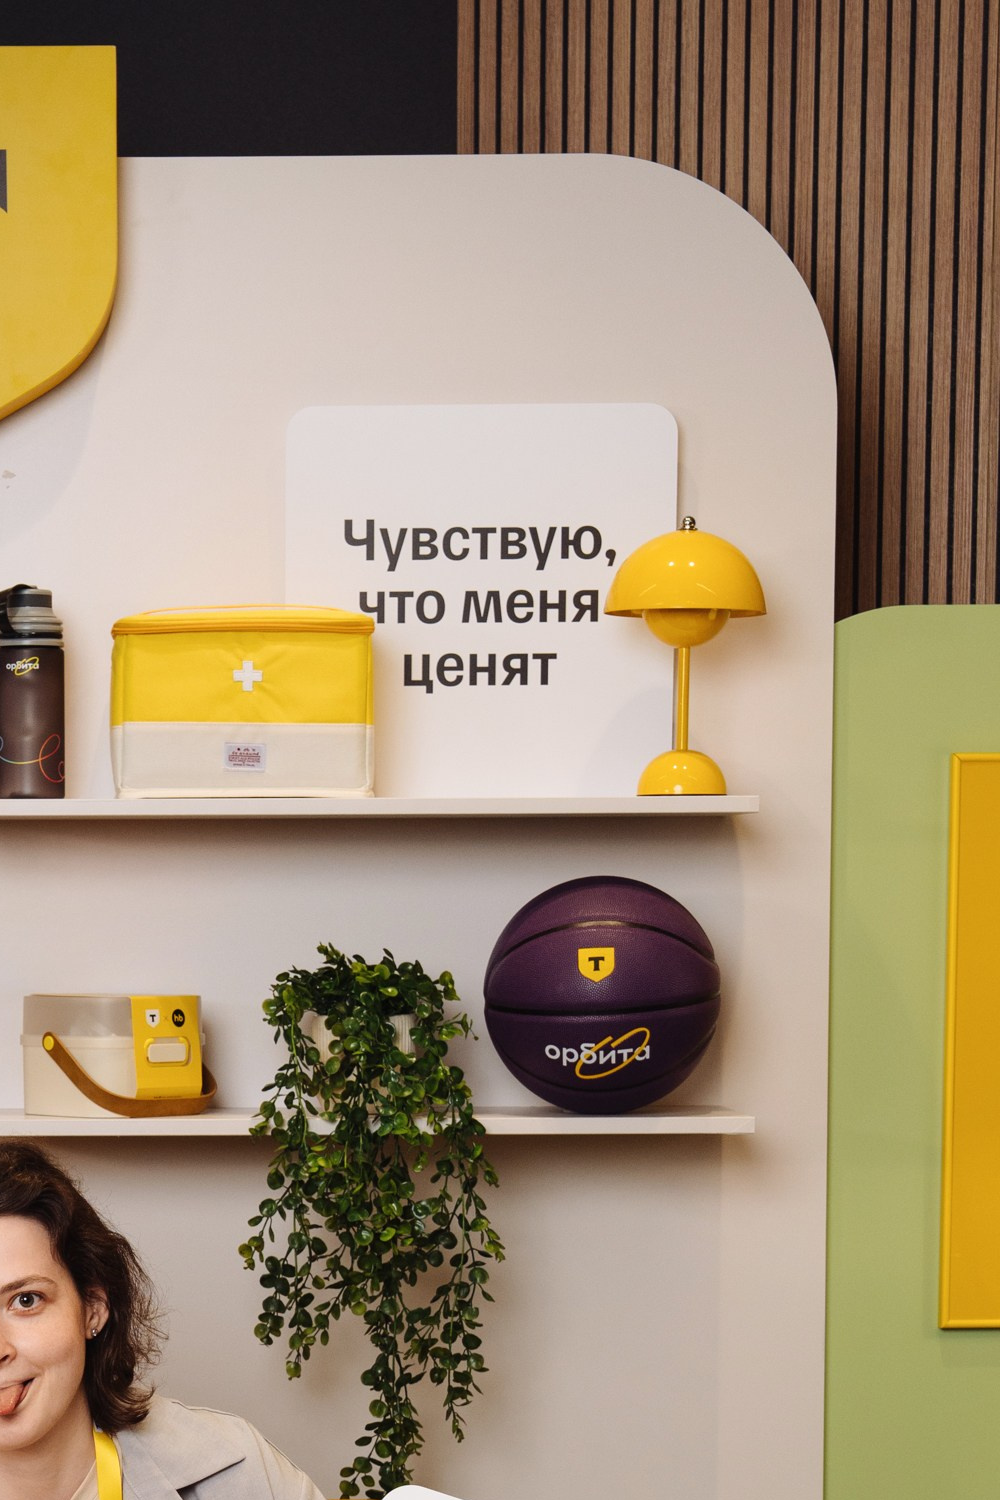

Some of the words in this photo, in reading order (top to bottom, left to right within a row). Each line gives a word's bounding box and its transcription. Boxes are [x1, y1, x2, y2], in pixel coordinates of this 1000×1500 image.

[344, 518, 617, 572] Чувствую,
[359, 590, 446, 624] что
[461, 589, 600, 624] меня
[5, 660, 40, 672] орбита
[403, 652, 557, 694] ценят
[544, 1042, 651, 1067] орбита
